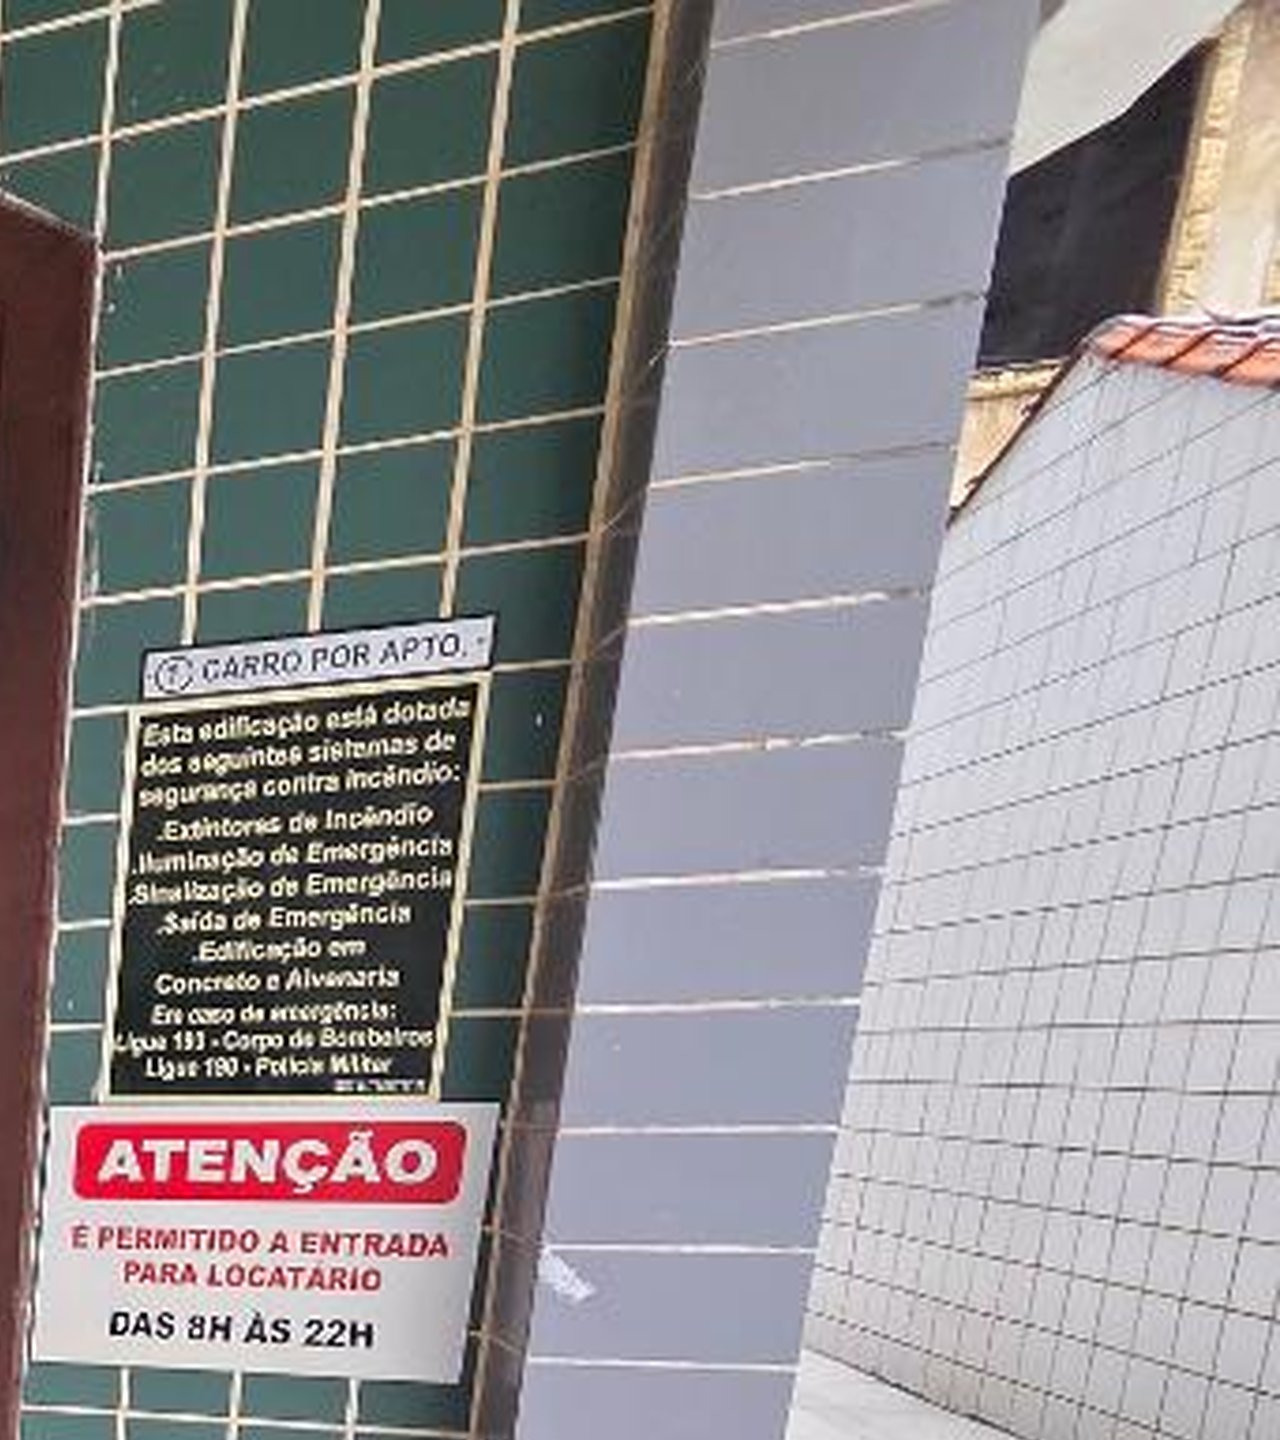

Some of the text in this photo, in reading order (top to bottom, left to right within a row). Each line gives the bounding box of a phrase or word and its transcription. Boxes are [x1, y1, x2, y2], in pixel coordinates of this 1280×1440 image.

[203, 655, 302, 683] CARRO
[312, 644, 370, 672] POR
[379, 633, 468, 665] APTO.
[143, 698, 470, 746] Esta edificação está dotada
[141, 730, 457, 777] dos seguintes sistemas de
[141, 763, 461, 810] segurança contra incêndio:
[289, 811, 317, 832] de
[326, 805, 433, 830] Incêndio
[270, 844, 299, 864] de
[306, 836, 454, 864] Emergência
[270, 876, 299, 896] de
[306, 866, 453, 897] Emergência
[233, 908, 261, 928] de
[270, 902, 412, 931] Emergência
[328, 939, 367, 956] em
[155, 964, 400, 995] Concreto e Alvenaria
[152, 1003, 183, 1025] Em
[188, 1007, 234, 1025] caso
[240, 1004, 265, 1023] de
[223, 1029, 284, 1053] Corpo
[290, 1028, 315, 1048] de
[320, 1023, 435, 1048] Bombeiros
[145, 1057, 200, 1081] Ligue
[95, 1129, 439, 1195] ATENÇÃO
[71, 1224, 450, 1259] É PERMITIDO A ENTRADA
[123, 1261, 198, 1285] PARA
[109, 1310, 375, 1350] DAS 8H ÀS 22H
